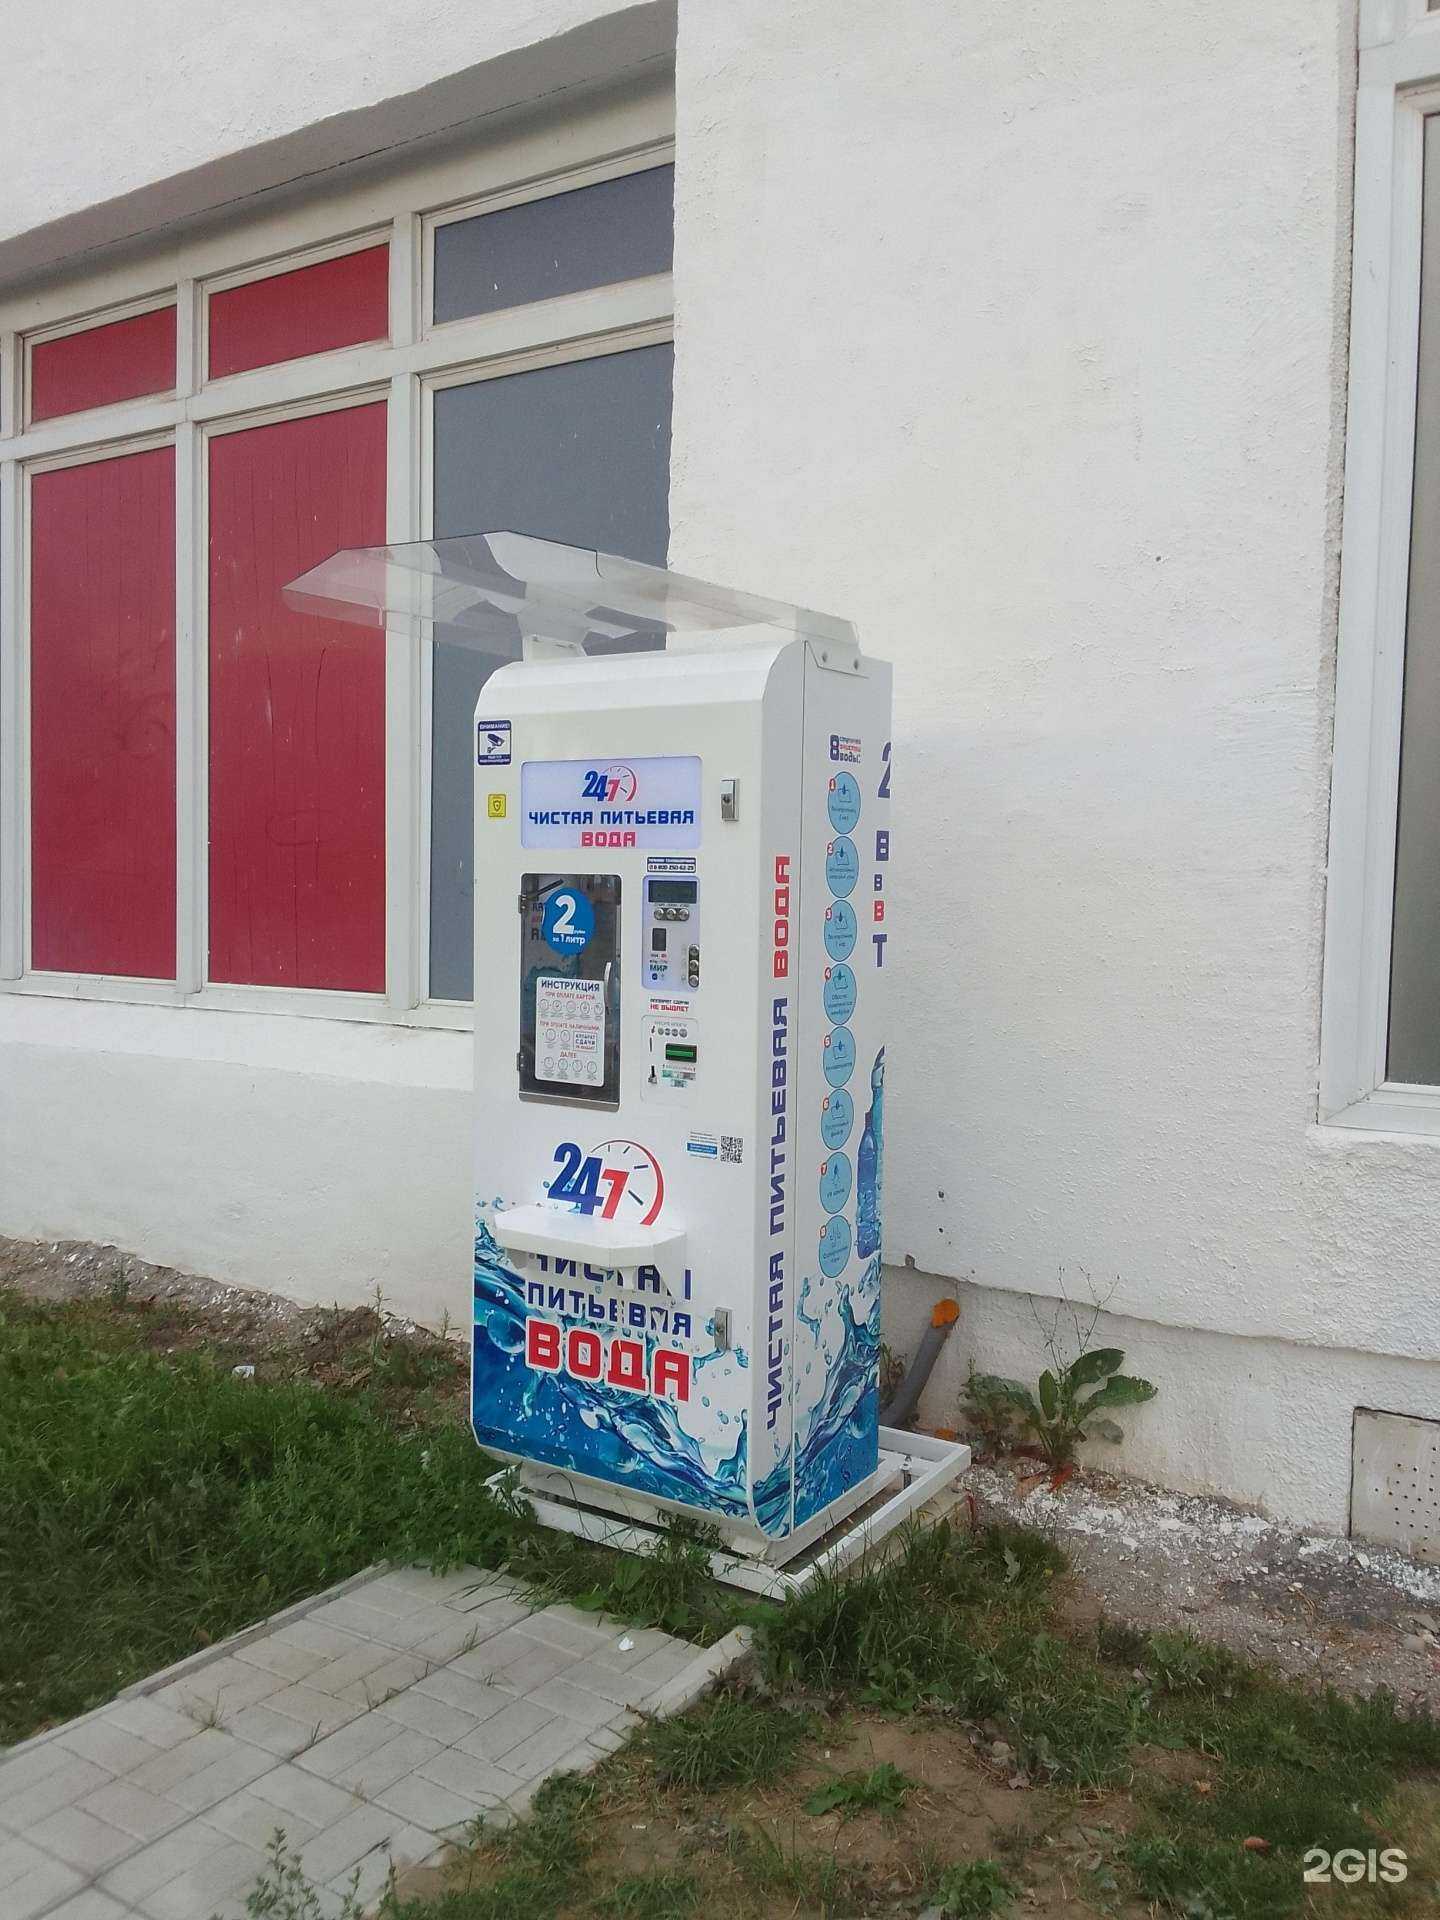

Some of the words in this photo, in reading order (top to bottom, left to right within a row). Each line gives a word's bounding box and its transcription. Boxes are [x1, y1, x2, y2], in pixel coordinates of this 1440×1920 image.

[829, 734, 840, 761] 8
[528, 810, 594, 825] ЧИСТАЯ
[600, 809, 695, 825] ПИТЬЕВАЯ
[581, 831, 637, 848] ВОДА
[552, 894, 576, 935] 2
[773, 855, 791, 978] ВОДА
[565, 936, 586, 947] литр
[541, 980, 600, 992] ИНСТРУКЦИЯ
[769, 997, 789, 1236] ПИТЬЕВАЯ
[766, 1250, 785, 1431] ЧИСТАЯ
[527, 1318, 691, 1403] ВОДА
